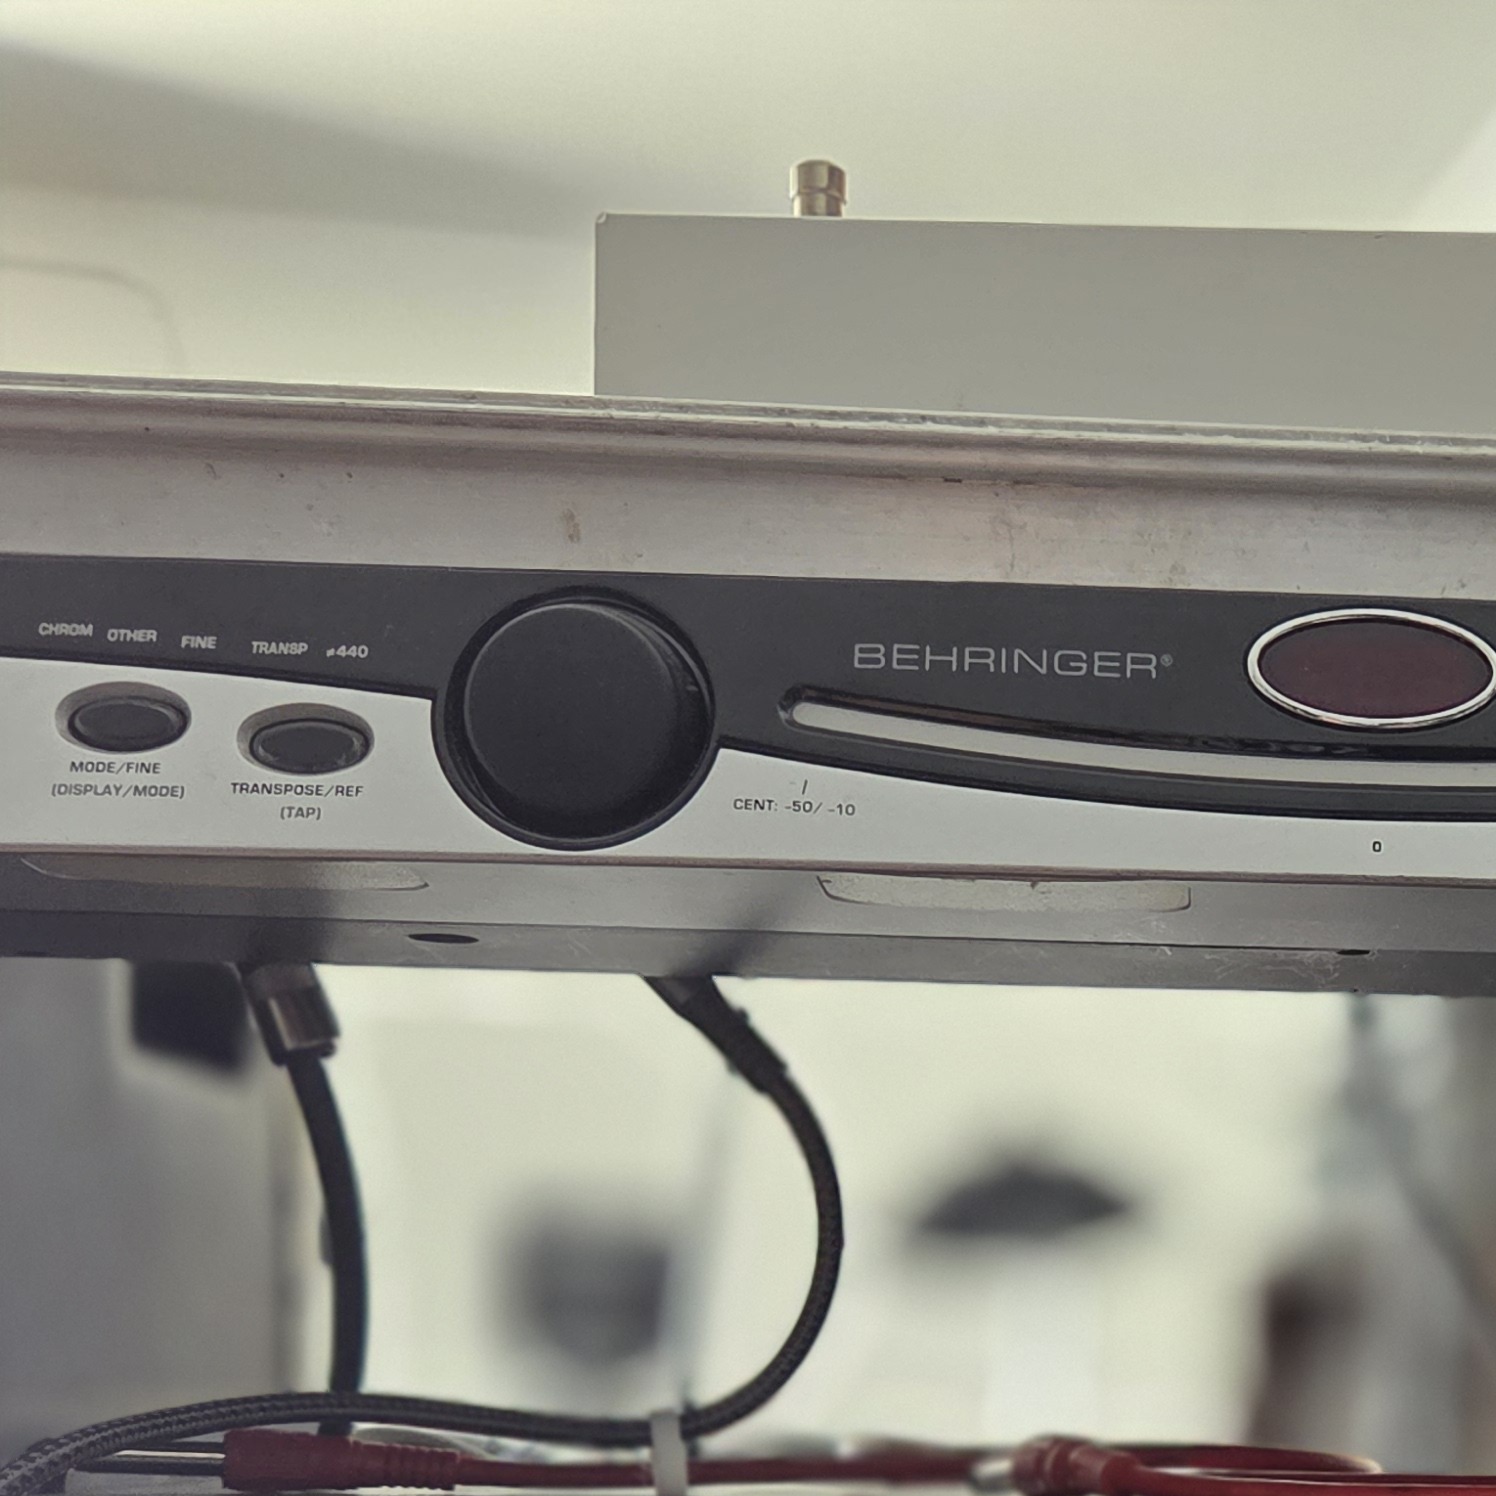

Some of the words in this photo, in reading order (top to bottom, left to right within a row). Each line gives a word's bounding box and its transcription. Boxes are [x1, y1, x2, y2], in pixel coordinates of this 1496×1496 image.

[38, 621, 93, 636] CHROM
[107, 627, 157, 643] OTHER
[181, 635, 217, 649] FINE
[251, 641, 309, 655] TRANSP
[69, 761, 161, 775] MODE/FINE
[51, 784, 185, 799] (DISPLAY/MODE)
[231, 783, 364, 797] TRANSPOSE/REF
[280, 806, 321, 820] (TAP)
[733, 798, 779, 811] CENT:
[784, 800, 823, 815] -50/
[827, 803, 856, 816] -10
[1372, 840, 1382, 853] 0
